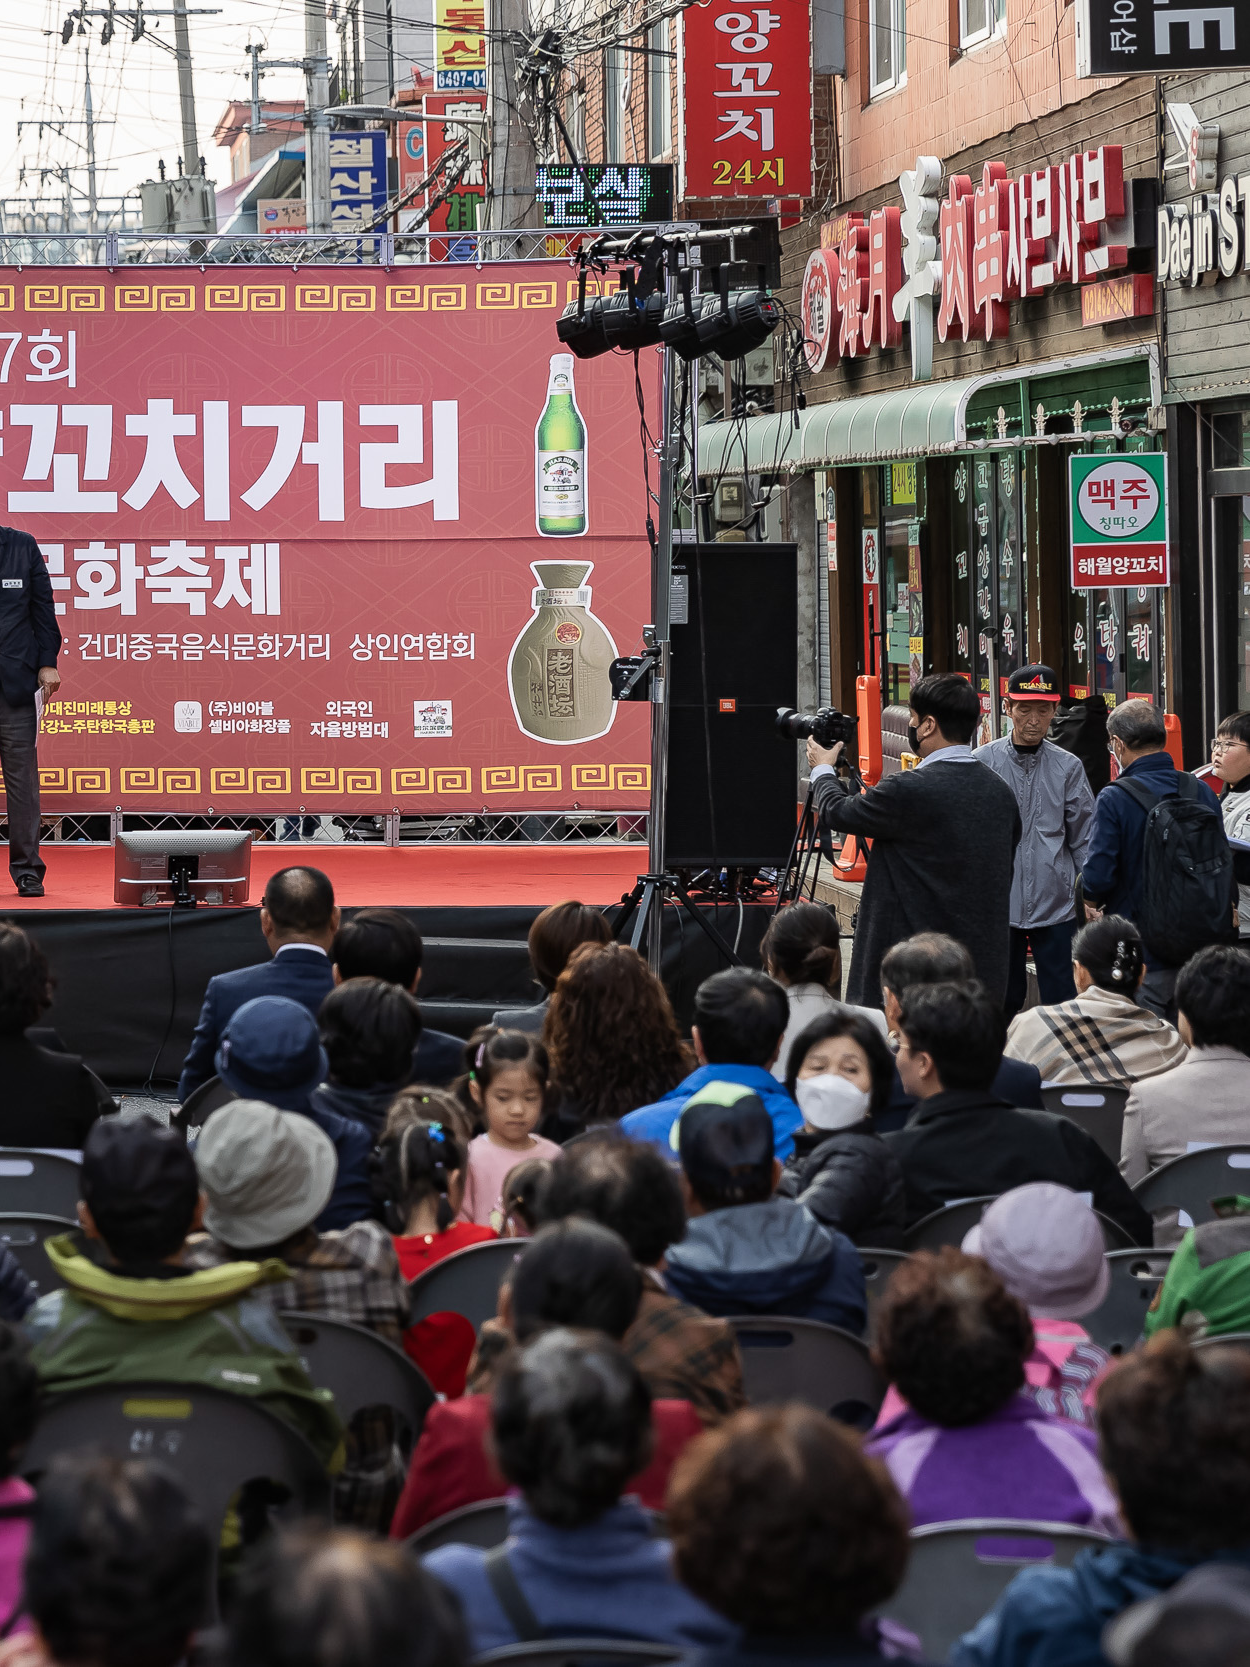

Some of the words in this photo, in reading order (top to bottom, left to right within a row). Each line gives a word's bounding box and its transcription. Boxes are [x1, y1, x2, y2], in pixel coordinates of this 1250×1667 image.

[713, 9, 781, 151] 양꼬치
[712, 158, 785, 187] 24시
[1007, 146, 1114, 297] 샤브샤브
[1157, 195, 1214, 287] Daejin
[1083, 283, 1133, 320] 02)462-5450
[1087, 478, 1151, 511] 맥주
[1099, 516, 1139, 531] 칭따오
[954, 461, 969, 658] 양꼬치
[999, 453, 1015, 656] 탕수육
[1078, 556, 1164, 576] 해월양꼬치
[78, 632, 331, 661] 건대중국음식문화거리
[349, 632, 476, 661] 상인연합회
[1018, 682, 1053, 691] TRIANGLE
[208, 700, 274, 717] (주)비아블
[325, 700, 374, 718] 외국인
[310, 721, 390, 739] 자율방범대
